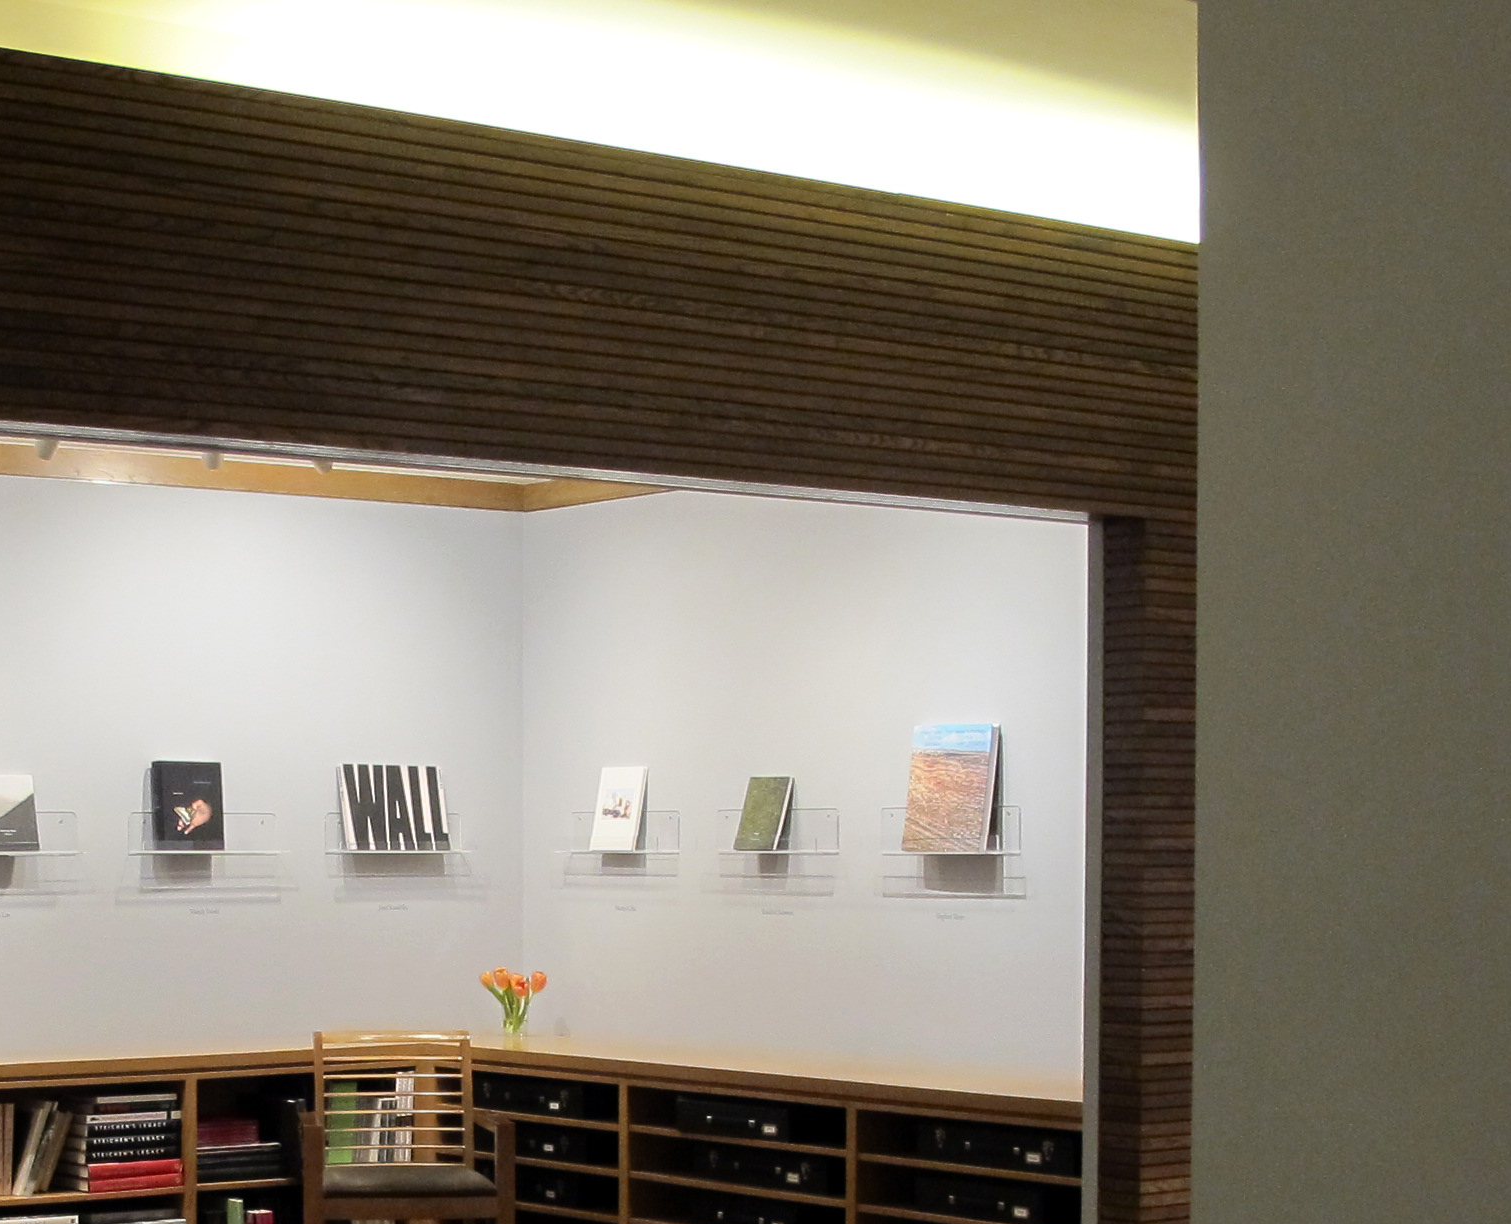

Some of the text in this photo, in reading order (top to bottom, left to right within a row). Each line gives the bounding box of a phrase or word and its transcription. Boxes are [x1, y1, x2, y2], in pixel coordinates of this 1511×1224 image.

[343, 764, 451, 851] WALL
[94, 1123, 136, 1131] STEICHEN'S
[93, 1136, 135, 1144] STEICHEN'S
[92, 1150, 134, 1158] STEICHEN'S
